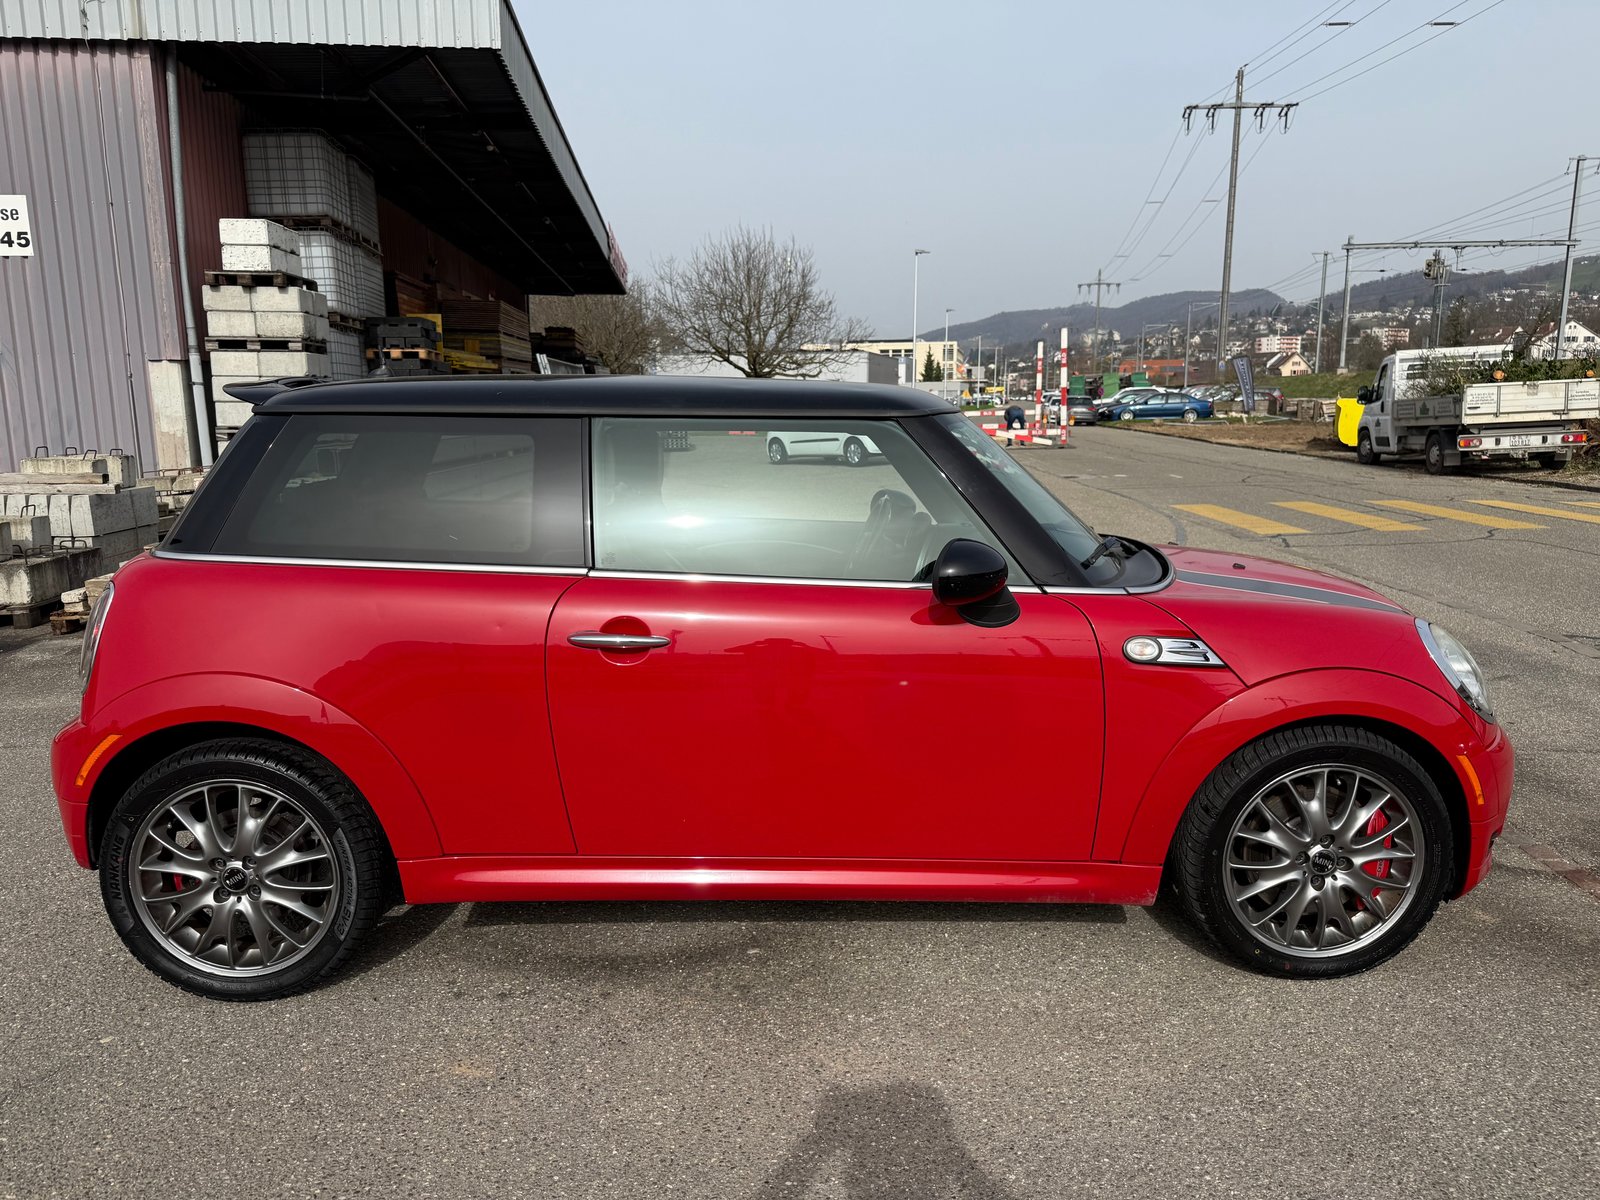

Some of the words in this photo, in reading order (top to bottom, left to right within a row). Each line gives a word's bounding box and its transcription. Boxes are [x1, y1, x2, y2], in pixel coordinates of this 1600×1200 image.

[108, 834, 125, 900] NANKANG
[225, 872, 245, 887] MINI
[338, 839, 352, 872] WINTER
[345, 876, 353, 905] ACTIVA
[1314, 856, 1333, 867] MINI
